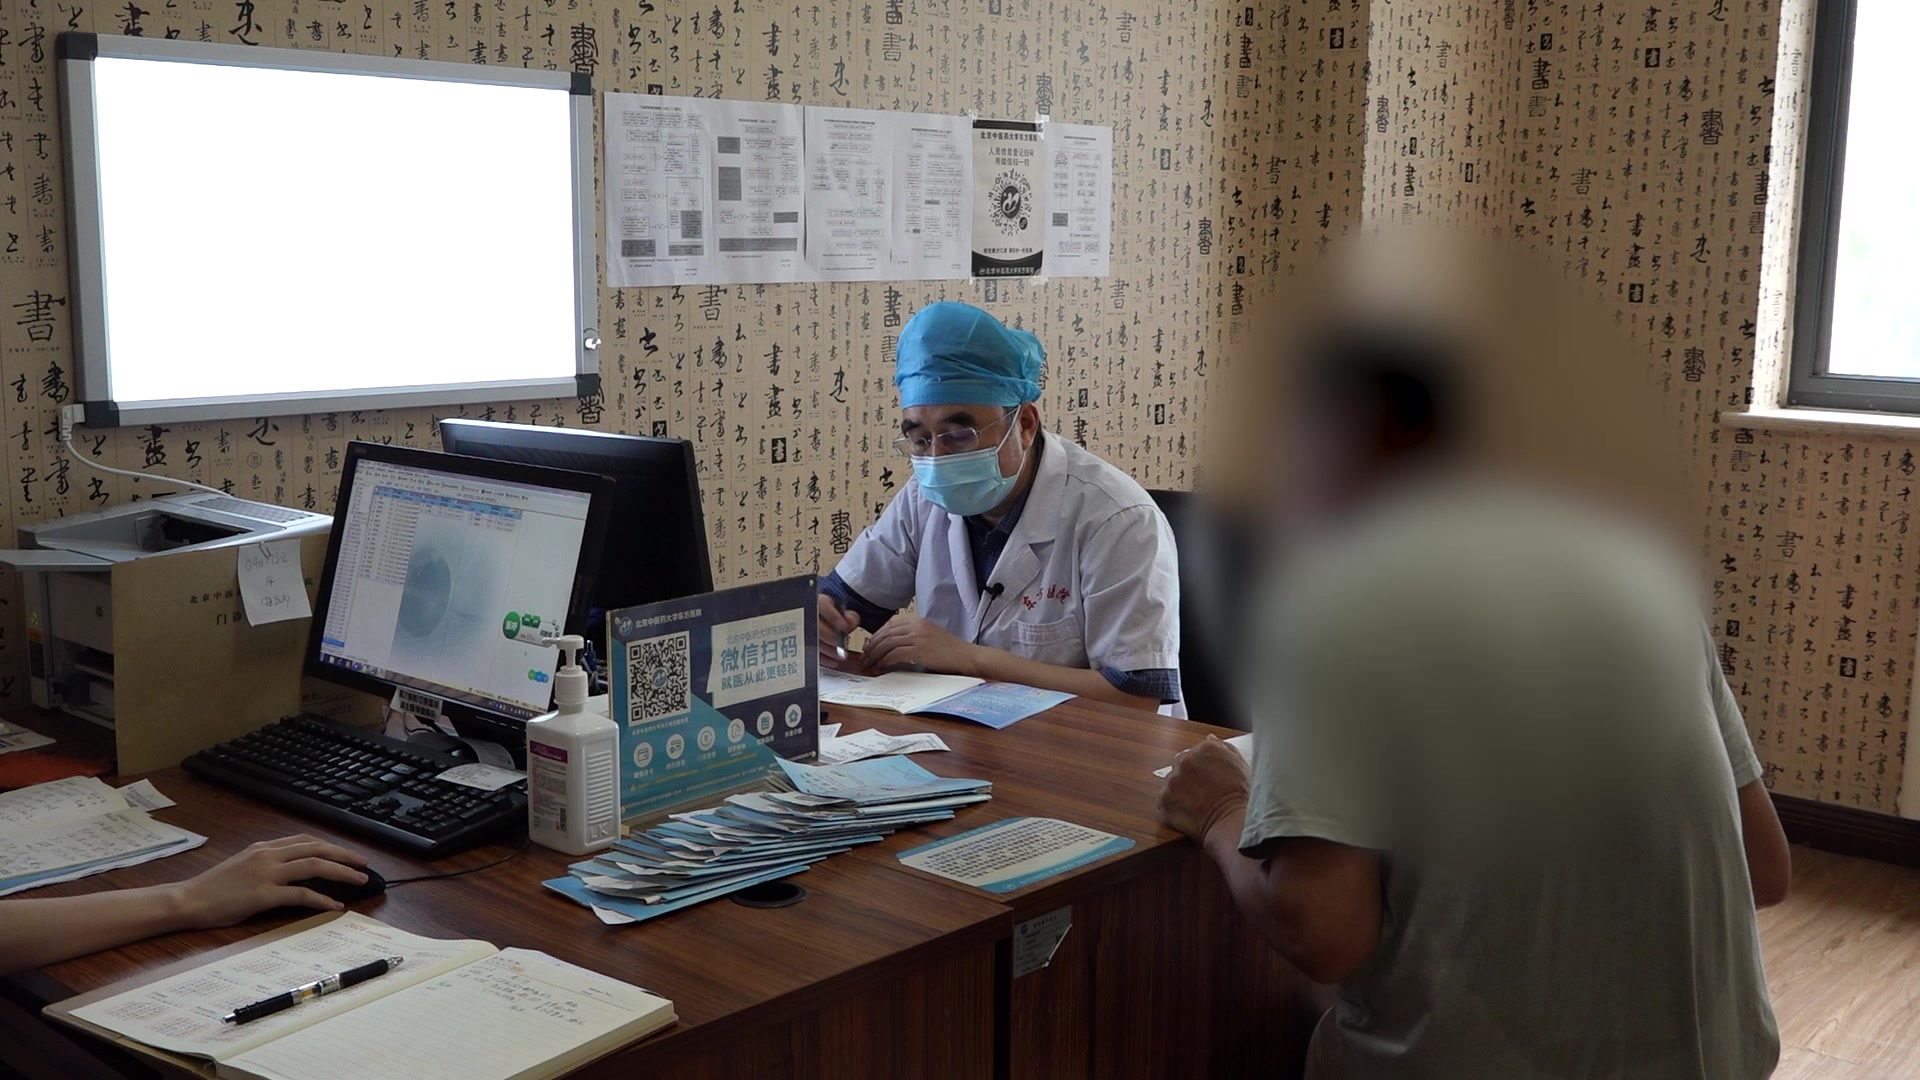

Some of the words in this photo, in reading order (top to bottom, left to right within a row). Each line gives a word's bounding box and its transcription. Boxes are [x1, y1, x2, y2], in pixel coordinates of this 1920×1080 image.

[189, 588, 242, 605] 北京中医
[635, 608, 702, 630] 北京中医药大学东方医院
[726, 621, 797, 645] 北京中医药大学东方医院
[720, 634, 798, 674] 微信扫码
[720, 661, 799, 691] 就医从此更轻松
[589, 823, 609, 840] LK
